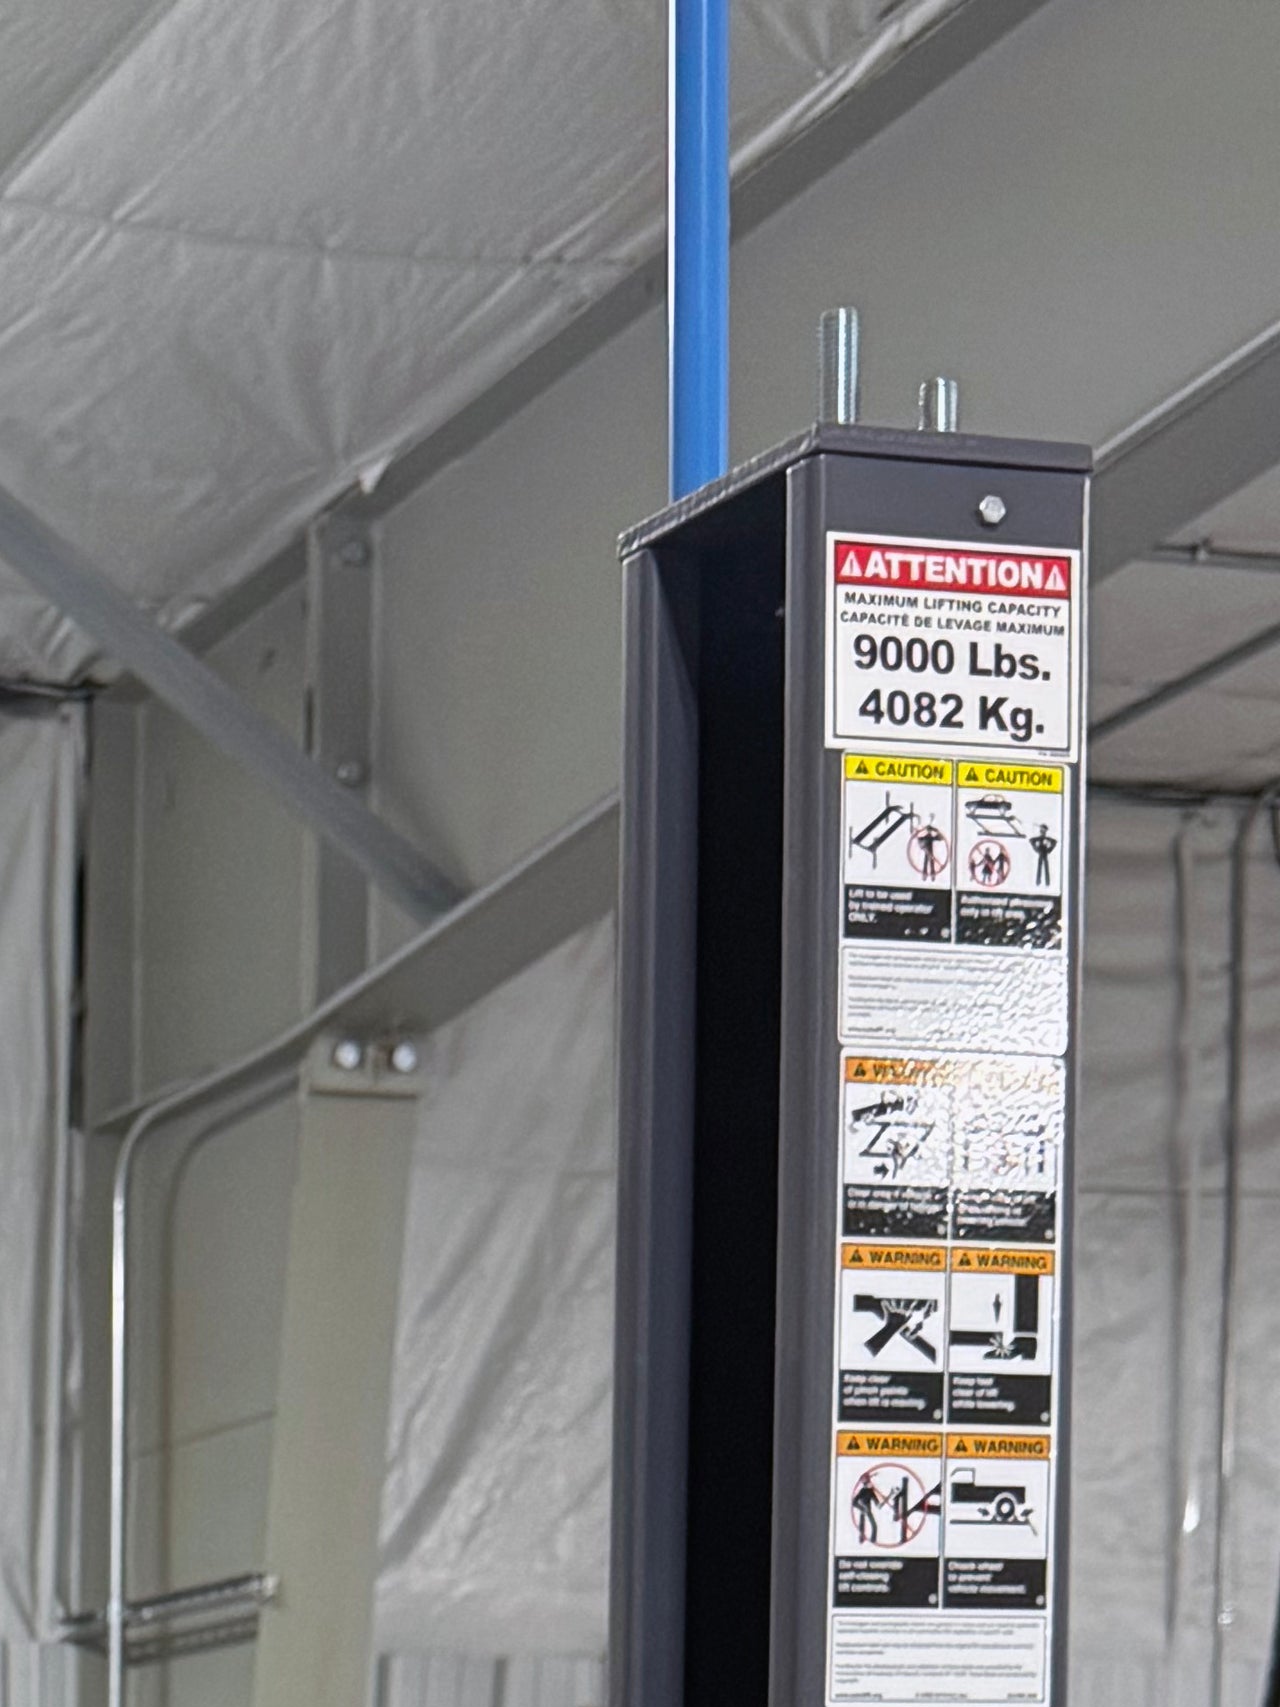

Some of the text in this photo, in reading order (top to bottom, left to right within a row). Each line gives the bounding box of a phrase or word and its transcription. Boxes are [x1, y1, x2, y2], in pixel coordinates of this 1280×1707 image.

[864, 551, 1044, 589] ATTENTION
[844, 592, 1061, 618] MAXIMUM LIFTING CAPACITY
[840, 611, 1065, 636] CAPACITÉ DE LEVAGE MAXIMUM
[853, 634, 1051, 681] 9000 Lbs.
[859, 688, 1045, 742] 4082 Kg.
[874, 761, 944, 780] CAUTION
[984, 767, 1052, 786] CAUTION
[868, 1250, 941, 1266] WARNING
[976, 1253, 1047, 1269] WARNING
[866, 1437, 939, 1451] WARNING
[973, 1439, 1044, 1454] WARNING
